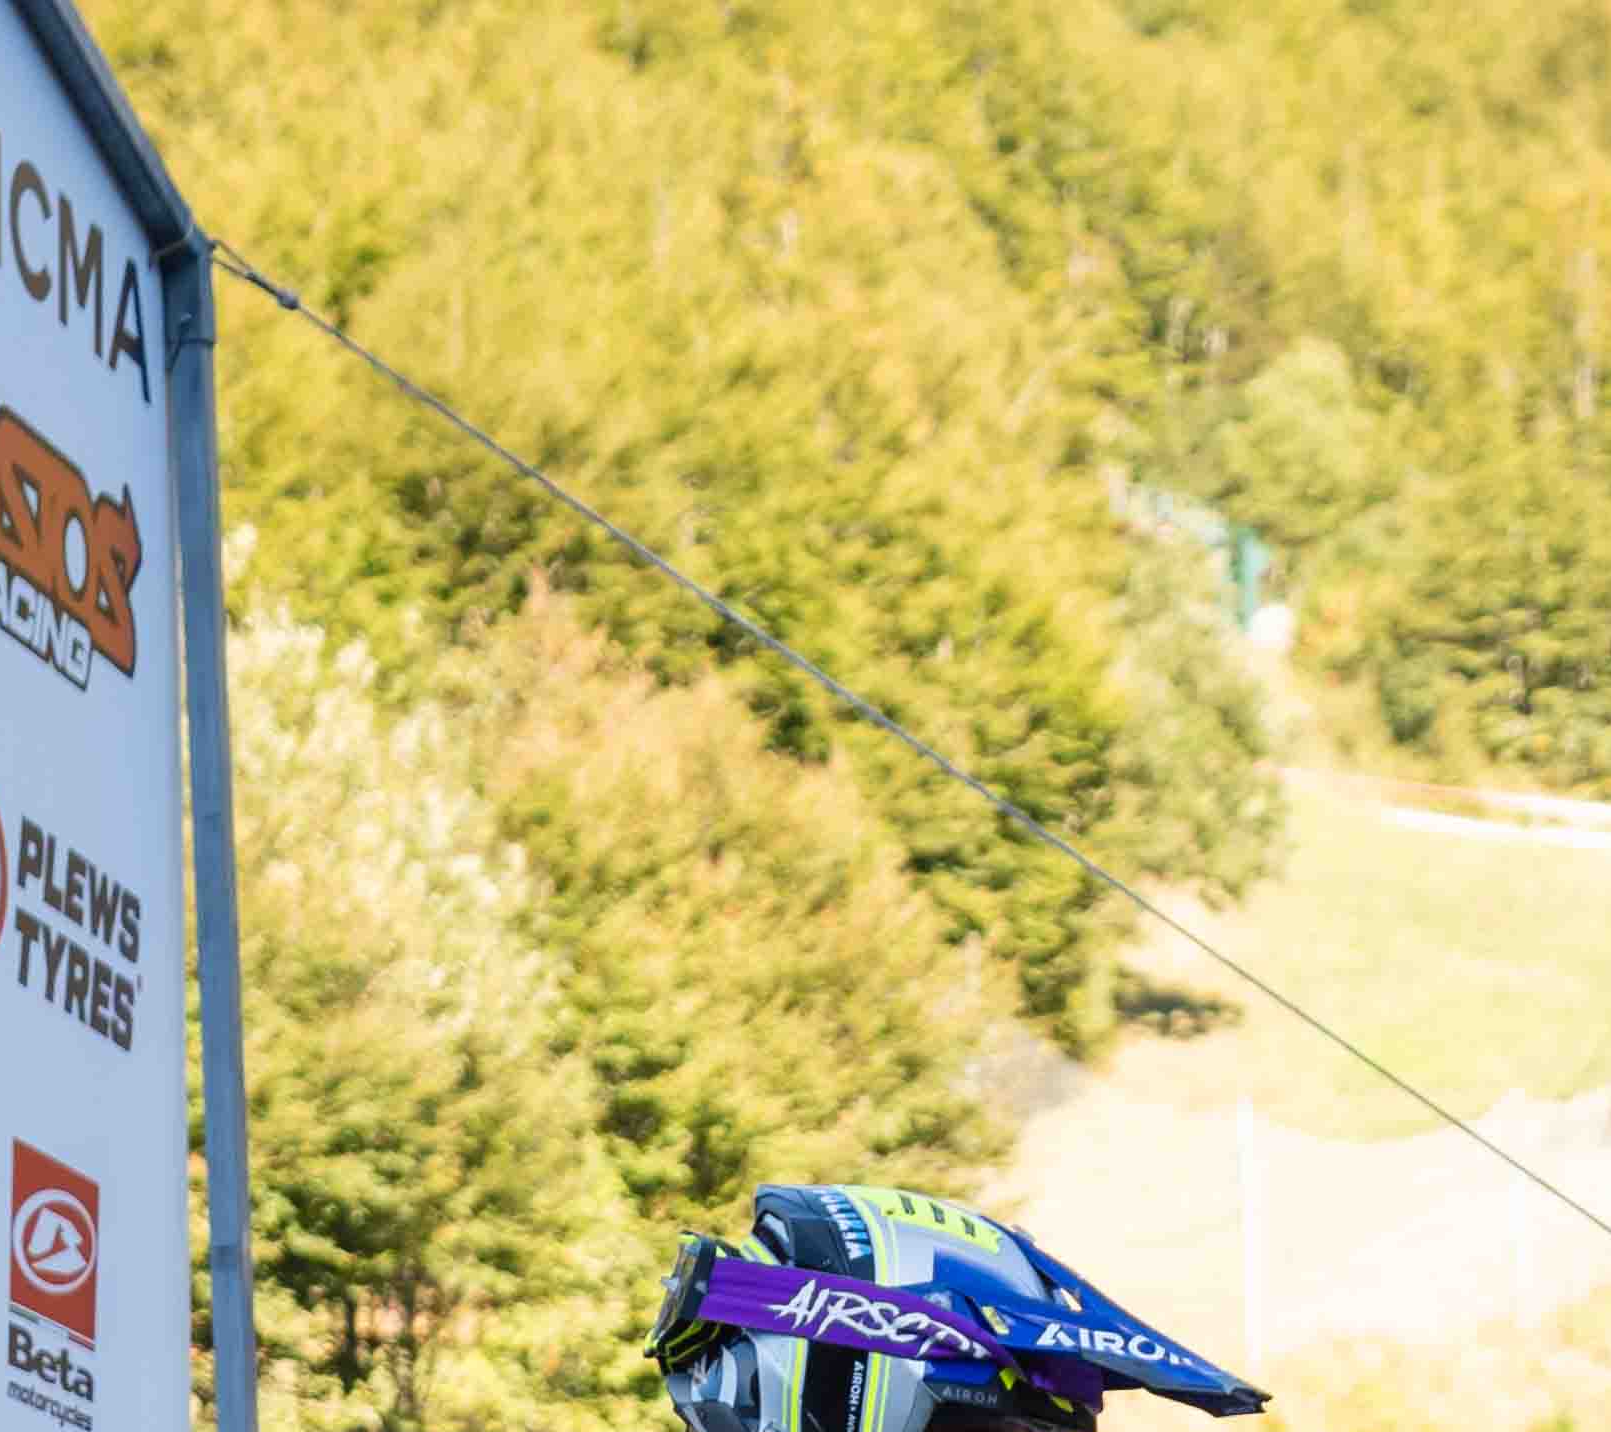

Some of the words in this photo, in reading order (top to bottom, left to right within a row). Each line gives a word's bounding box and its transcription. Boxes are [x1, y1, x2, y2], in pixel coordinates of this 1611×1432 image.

[17, 814, 141, 964] PLEWS
[15, 905, 135, 1053] TYRES
[6, 1380, 93, 1432] motorcycles
[7, 1320, 95, 1403] Beta
